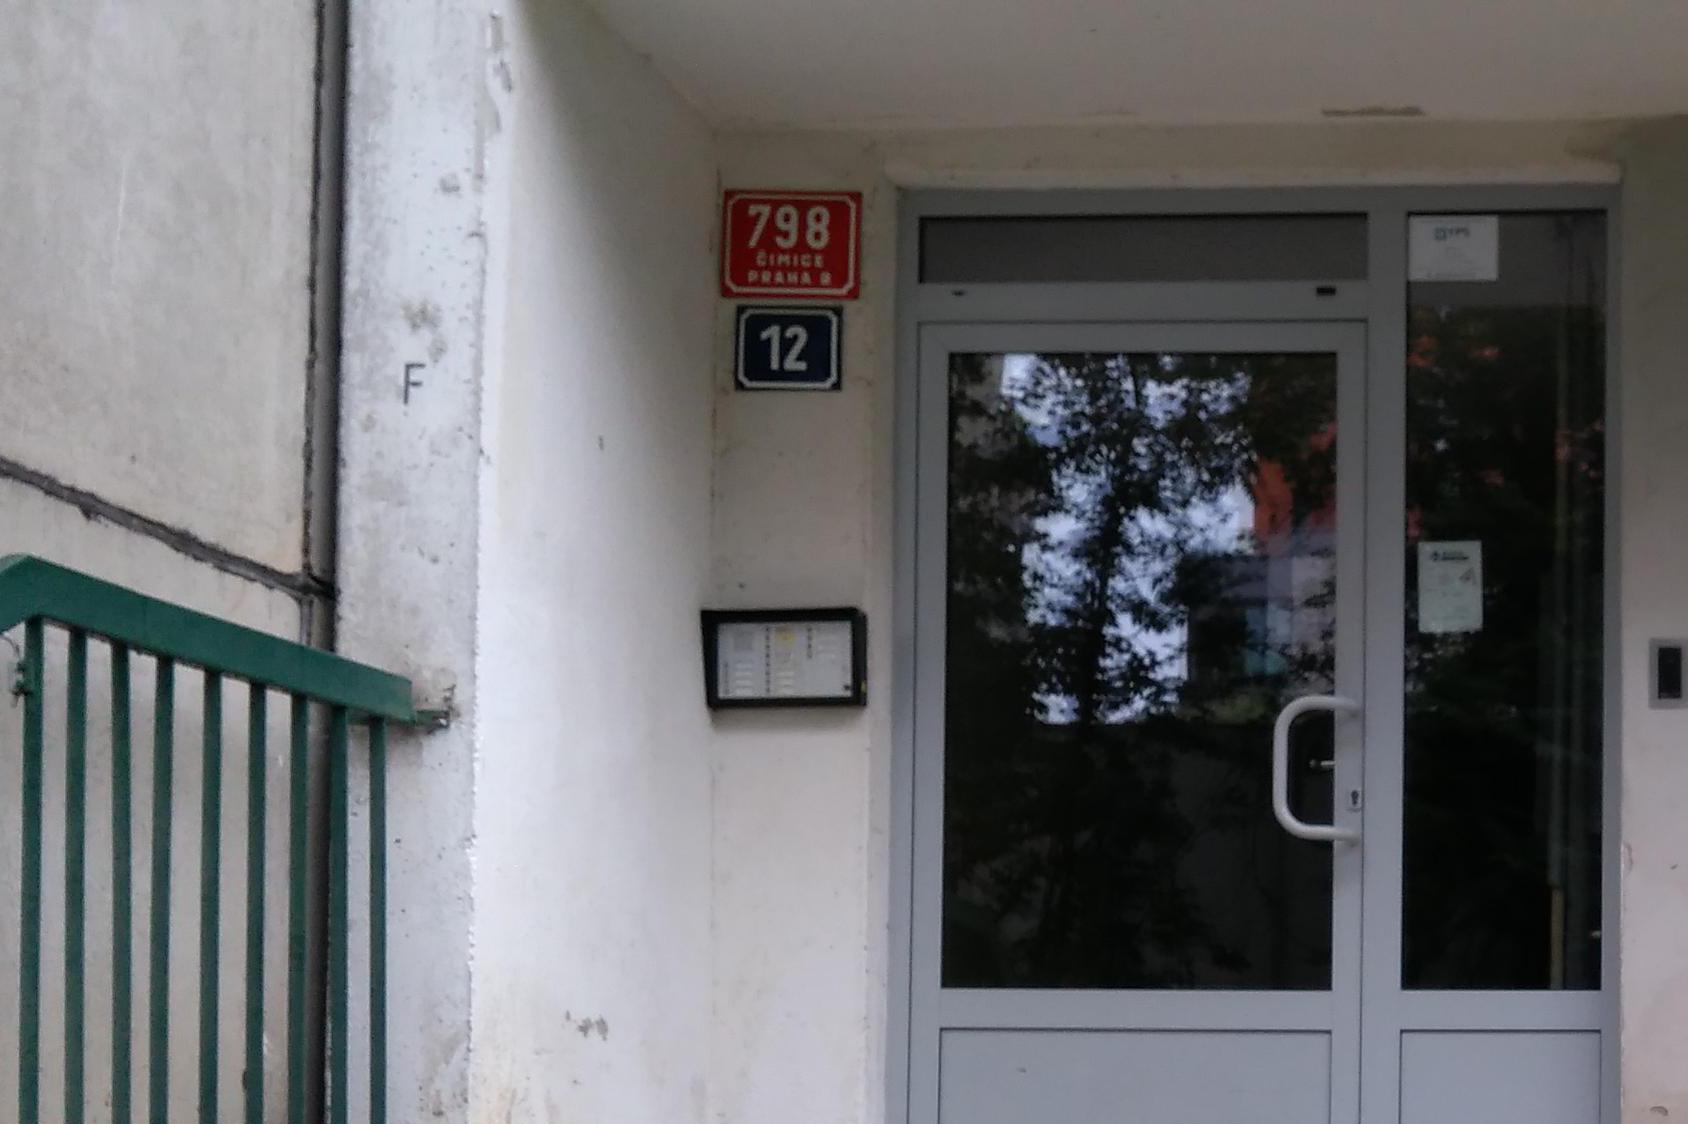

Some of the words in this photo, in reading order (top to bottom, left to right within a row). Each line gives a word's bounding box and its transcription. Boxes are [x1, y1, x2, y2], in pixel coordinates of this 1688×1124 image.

[748, 204, 830, 249] 798
[747, 270, 811, 285] PRAHA
[756, 249, 824, 268] ČIMICE
[760, 325, 808, 371] 12
[403, 362, 426, 404] F
